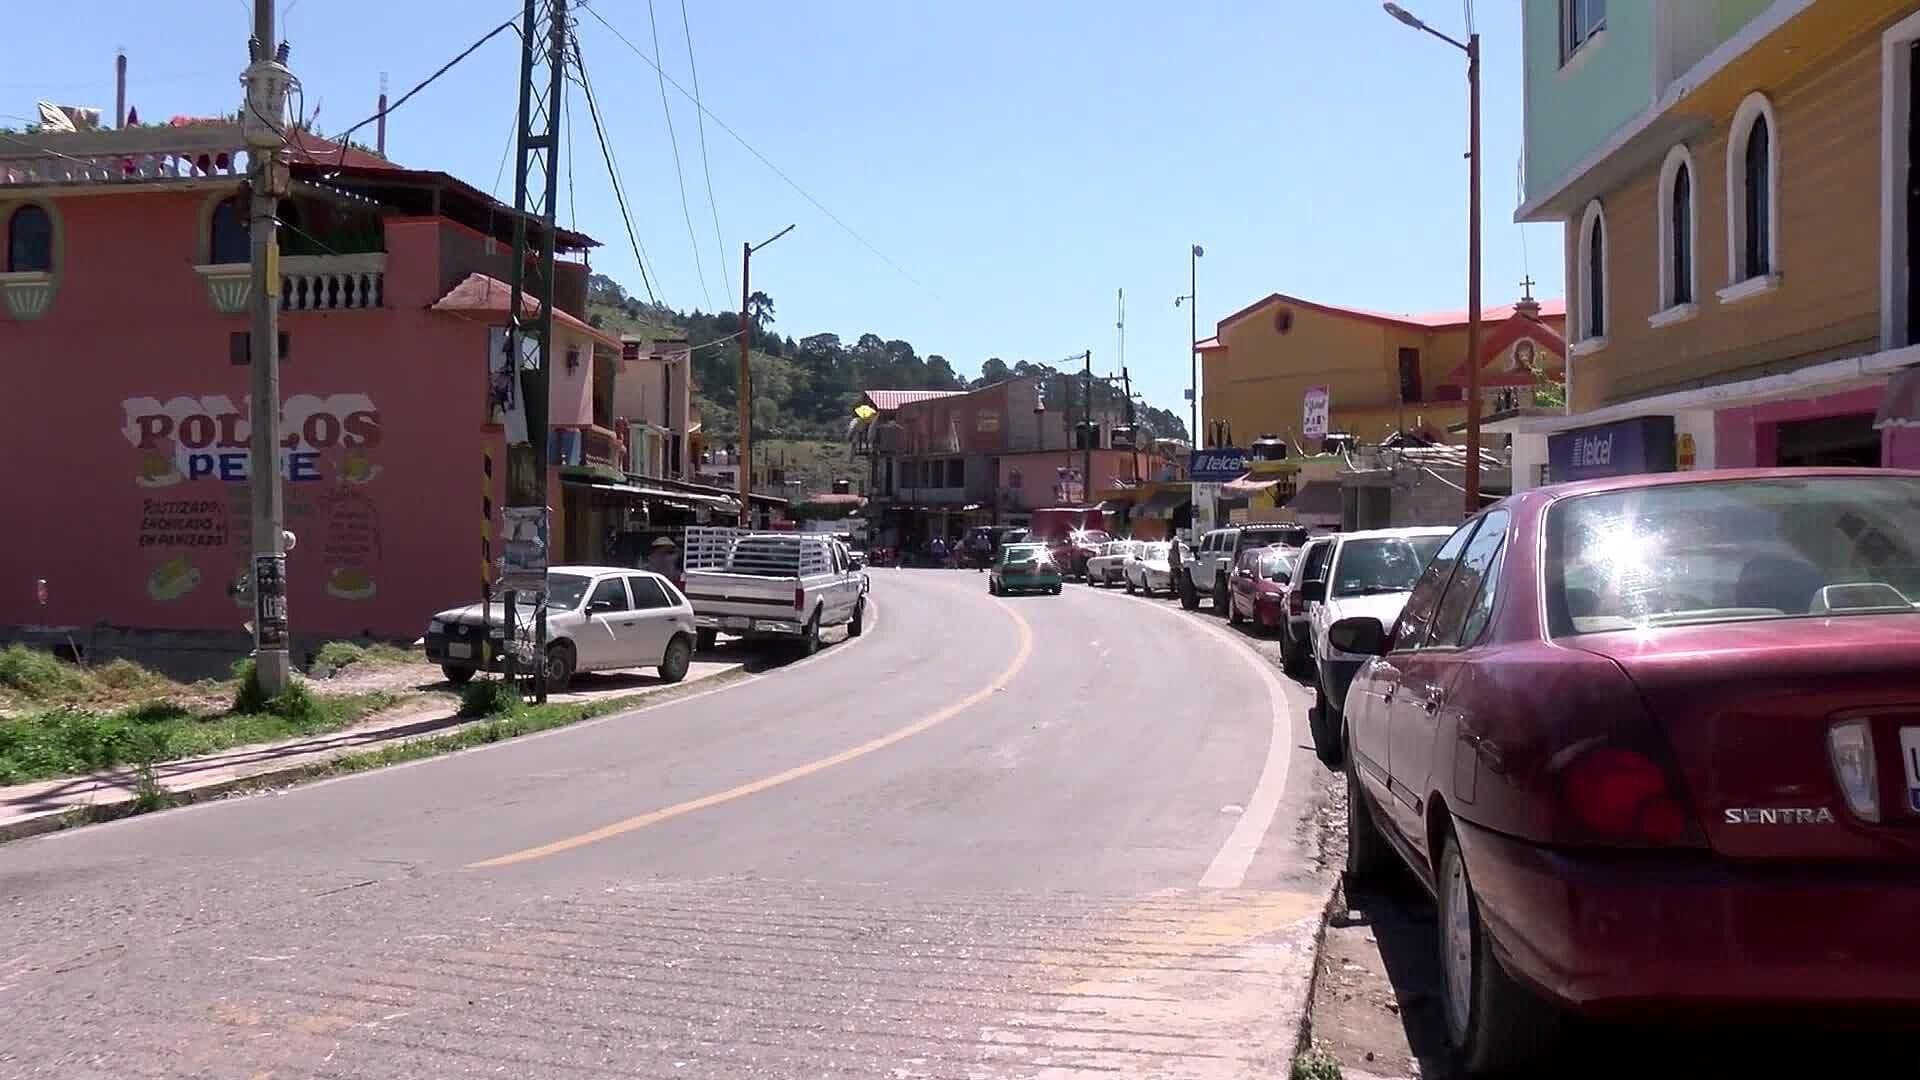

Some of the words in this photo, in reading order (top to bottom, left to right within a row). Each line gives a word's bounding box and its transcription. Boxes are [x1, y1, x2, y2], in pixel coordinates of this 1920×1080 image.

[1582, 432, 1613, 465] telcel
[188, 452, 322, 481] PEE
[1206, 455, 1243, 471] telcel
[1724, 807, 1836, 824] SENTRA
